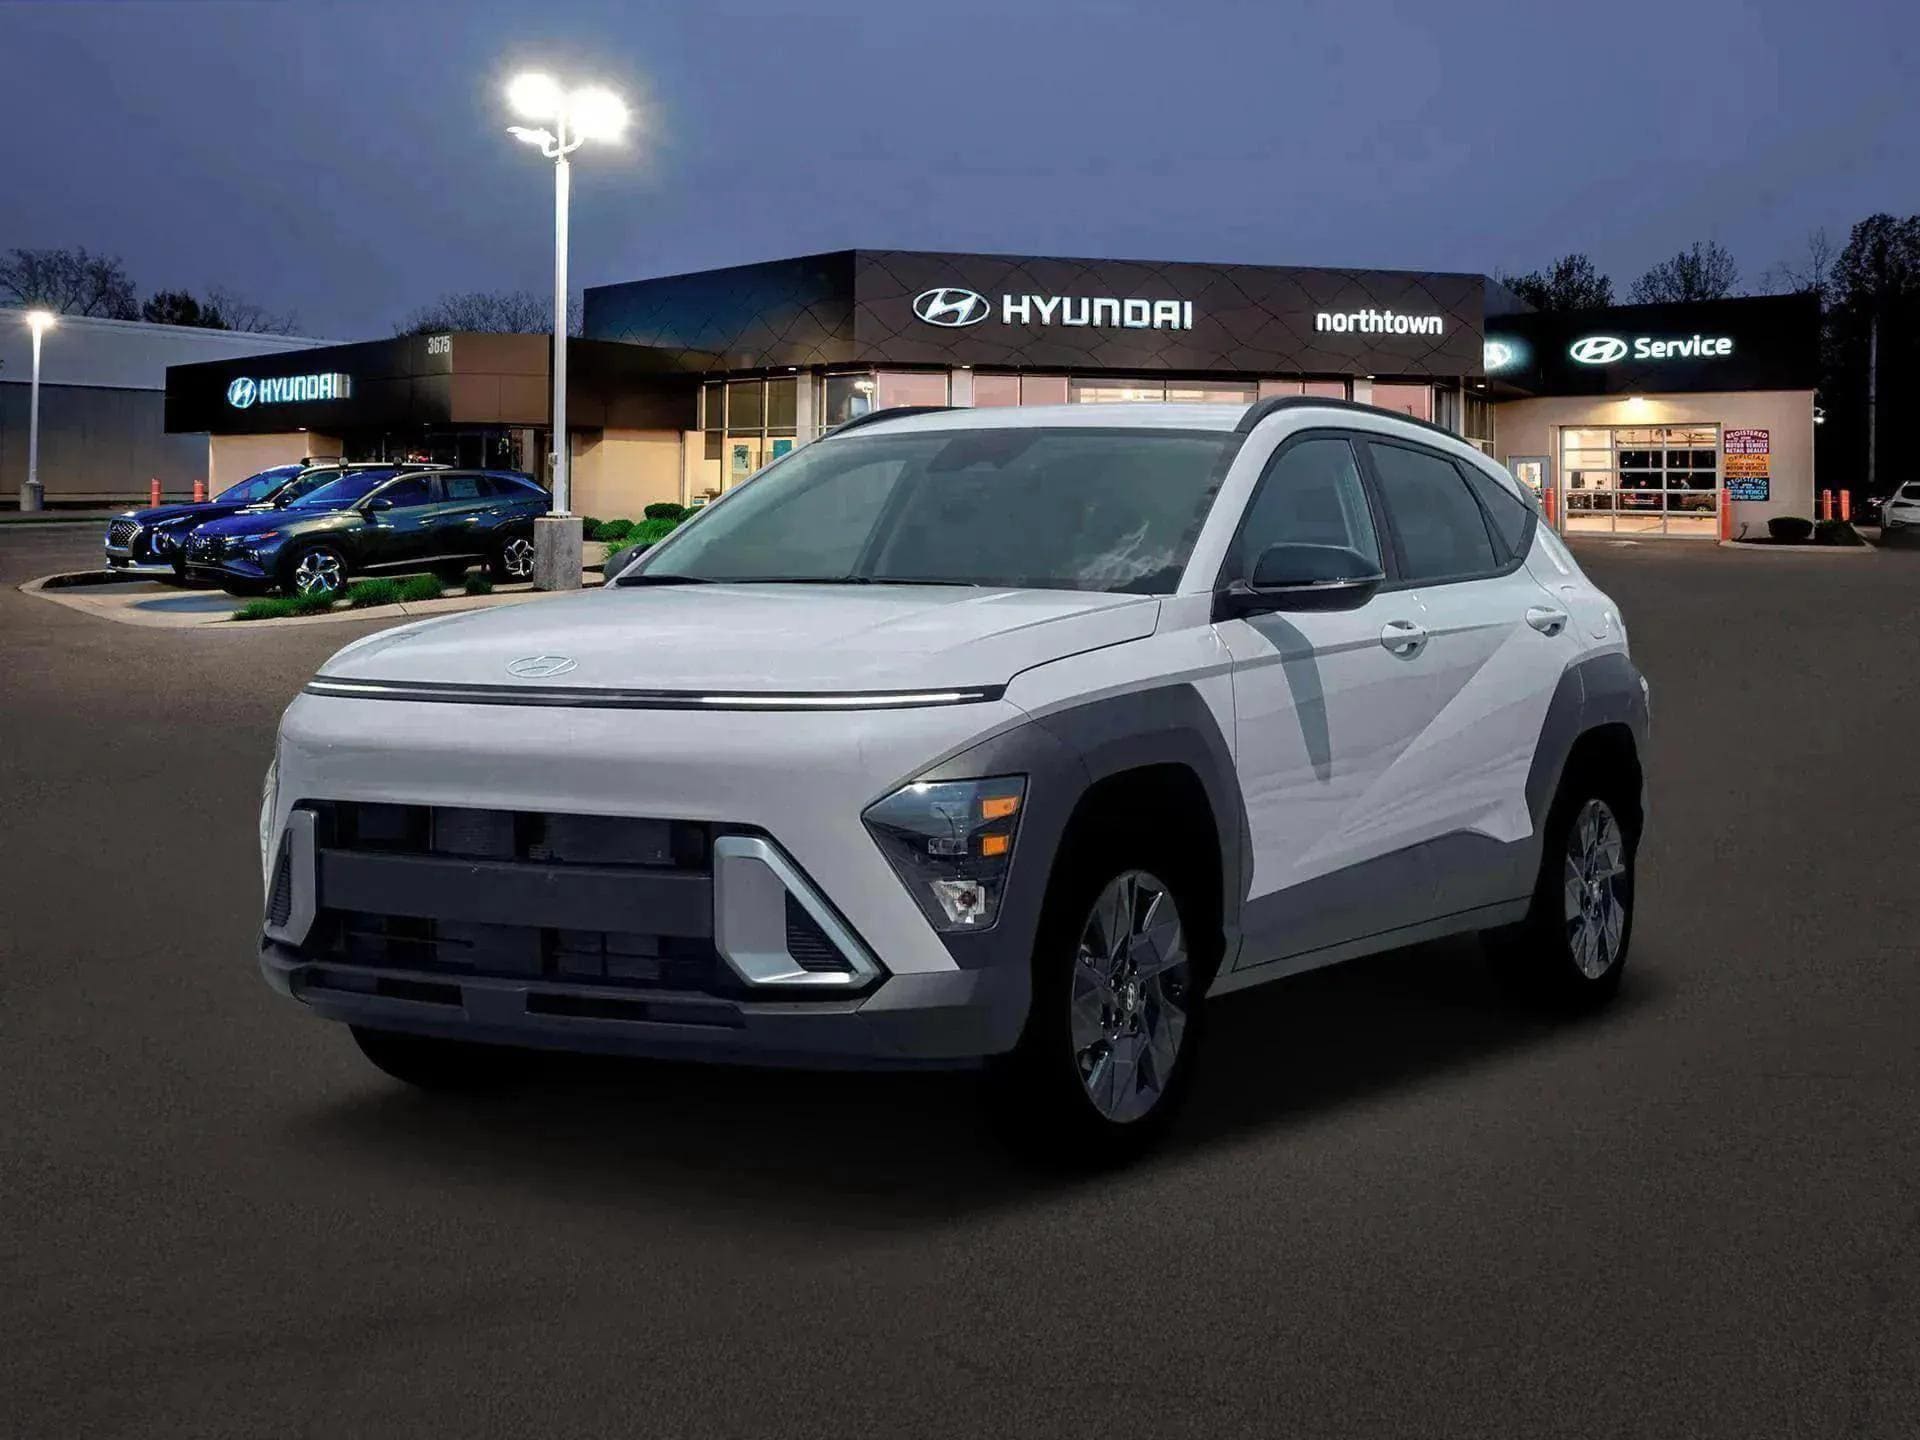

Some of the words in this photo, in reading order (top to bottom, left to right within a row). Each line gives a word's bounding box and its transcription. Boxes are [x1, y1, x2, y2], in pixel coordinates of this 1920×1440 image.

[1003, 294, 1193, 330] HYUNDAI
[1316, 309, 1443, 335] northtown
[427, 335, 450, 354] 3675
[1634, 334, 1733, 359] Service
[259, 373, 350, 404] HYUNDAI
